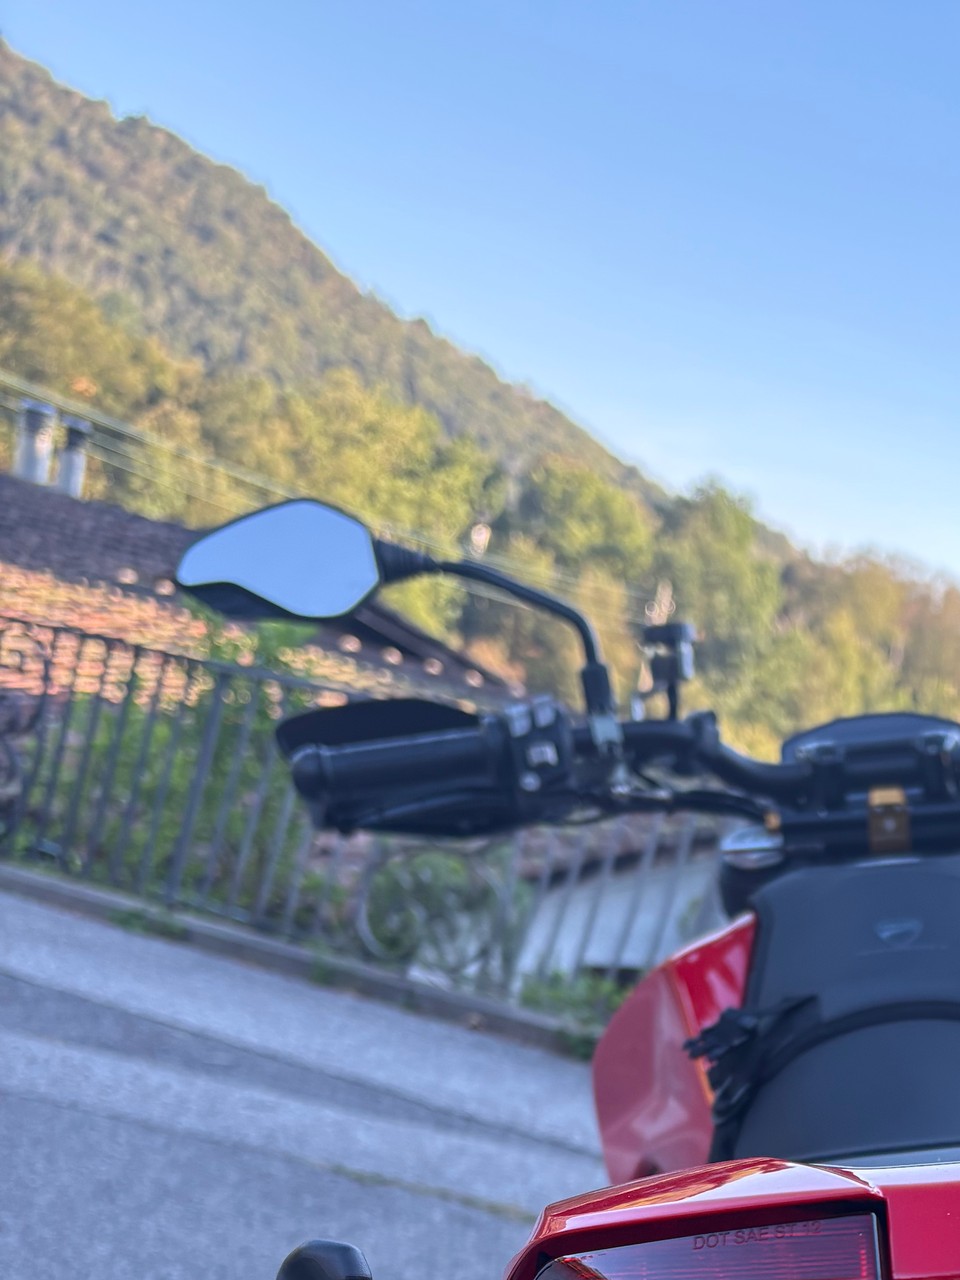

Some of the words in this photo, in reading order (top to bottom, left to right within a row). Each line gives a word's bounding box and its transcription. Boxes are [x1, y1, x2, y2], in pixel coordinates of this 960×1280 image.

[692, 1232, 730, 1250] DOT
[734, 1227, 769, 1245] SAE
[774, 1223, 797, 1239] ST
